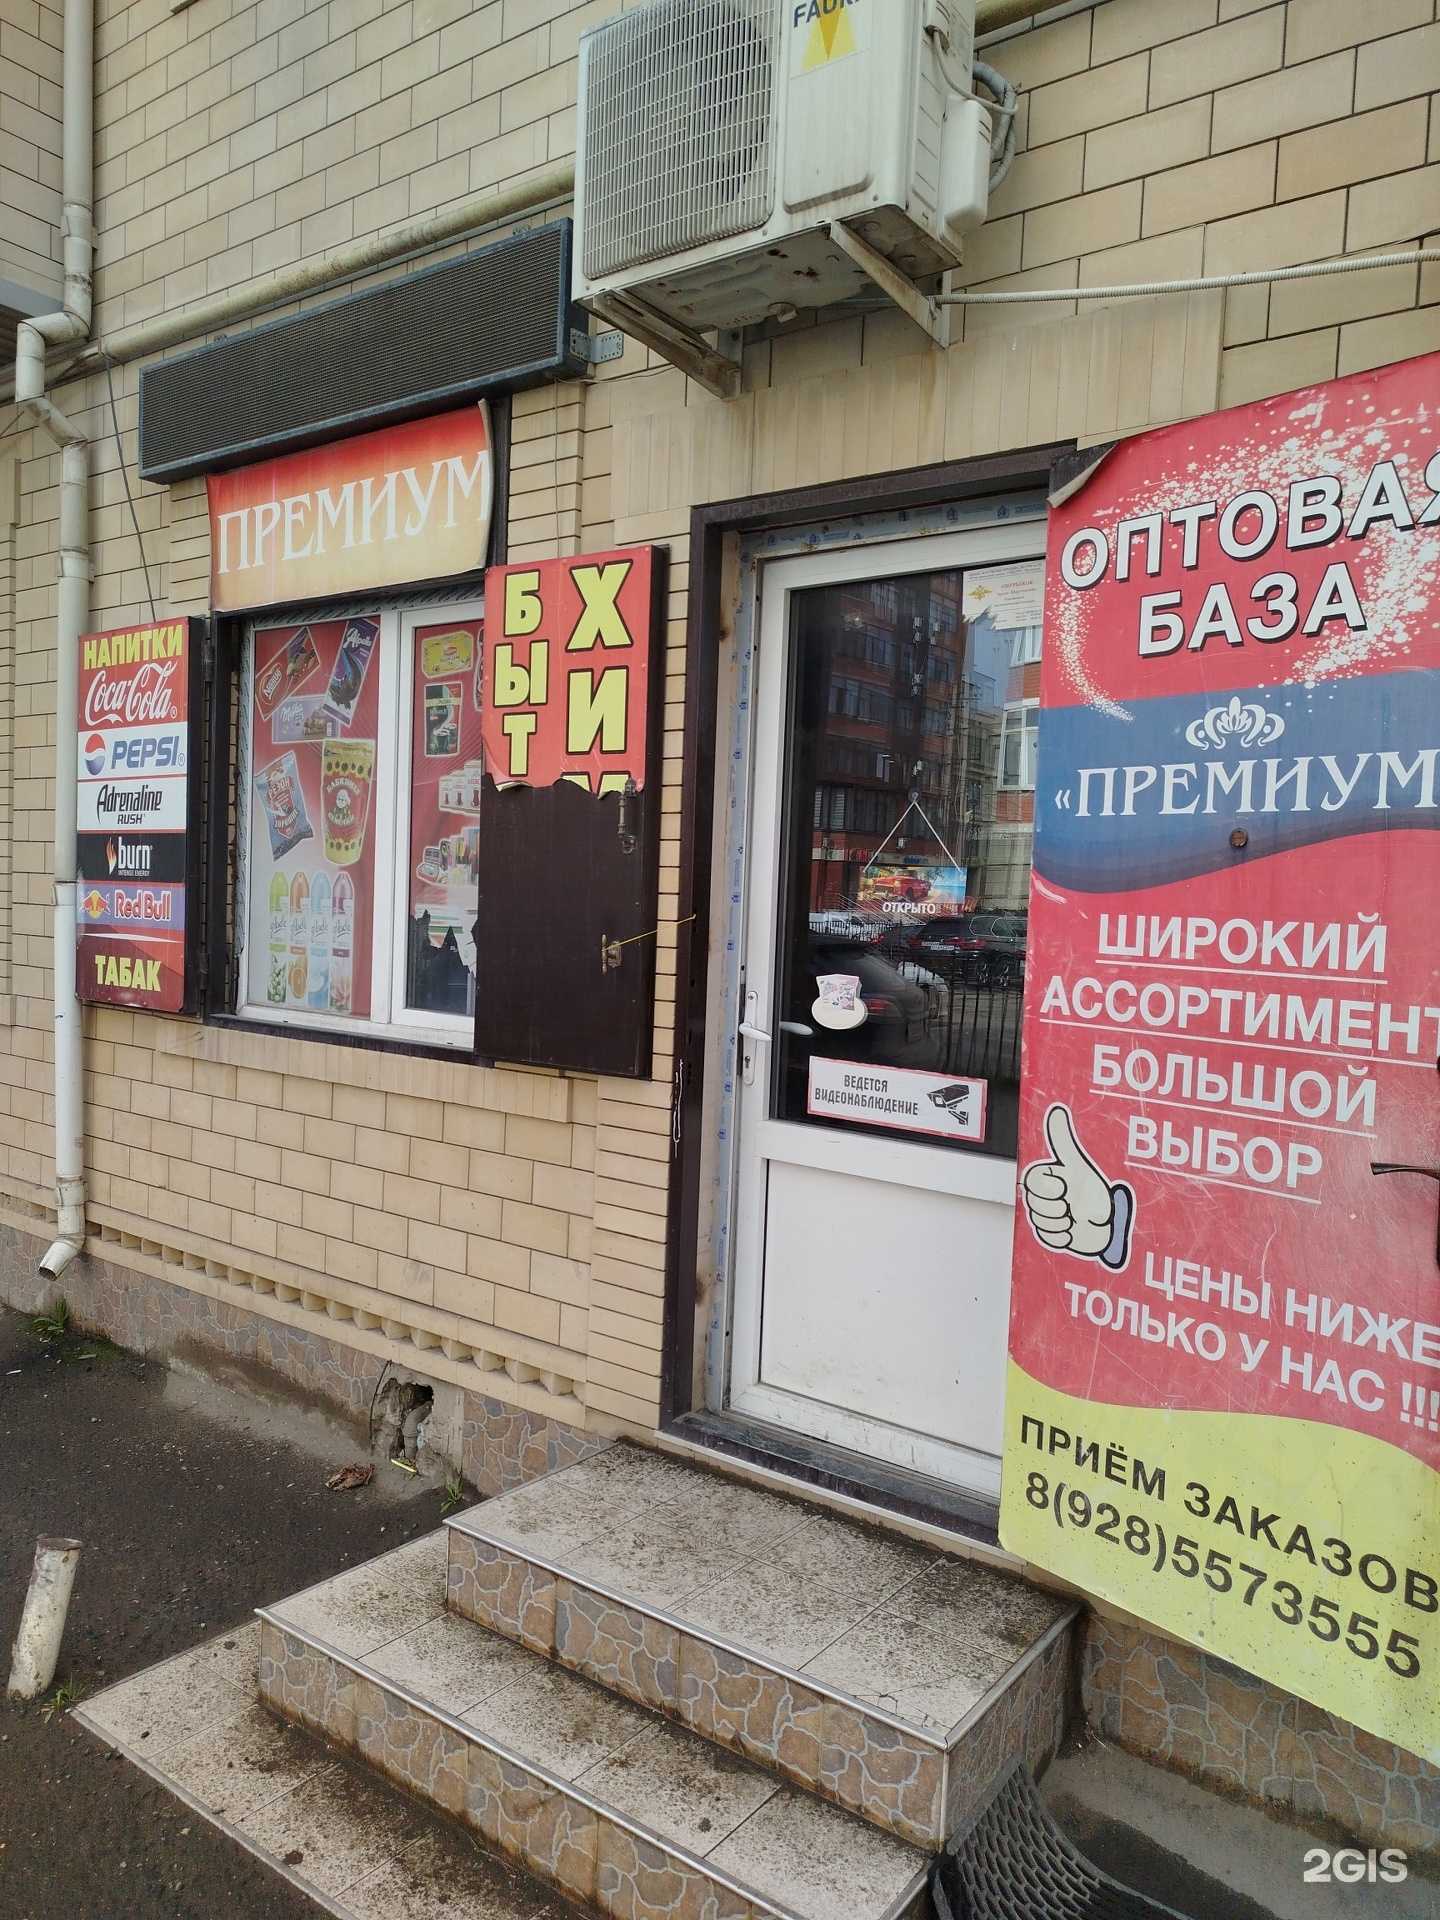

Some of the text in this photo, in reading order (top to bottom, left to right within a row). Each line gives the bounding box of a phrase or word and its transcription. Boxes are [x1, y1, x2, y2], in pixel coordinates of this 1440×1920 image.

[793, 0, 861, 28] FAU
[217, 450, 490, 574] ПРЕМИУМ
[1137, 561, 1367, 657] БАЗА
[84, 624, 183, 670] НАПИТКИ
[84, 660, 177, 727] Coca-Cola
[110, 735, 180, 769] PEPSI
[96, 784, 163, 824] Adrenaline
[117, 813, 143, 825] RUSH
[118, 836, 151, 869] burn
[114, 889, 172, 921] Red Bull
[882, 901, 936, 915] ОТКРЫТО
[1098, 911, 1388, 973] ШИРОКИЙ
[95, 954, 161, 992] ТАБАК
[814, 1087, 919, 1116] ВИДЕОНАБЛЮДЕНИЕ
[843, 1074, 889, 1093] ВЕДЕТСЯ
[1092, 1044, 1378, 1126] БОЛЬШОЙ
[1127, 1115, 1323, 1190] ВЫБОР
[1145, 1251, 1440, 1369] ЦЕНЫ НИЖЕ
[1064, 1281, 1227, 1362] ТОЛЬКО
[1239, 1333, 1269, 1373] У
[1281, 1351, 1386, 1413] НАС
[1020, 1414, 1440, 1615] ПРИЁМ ЗАКАЗОВ
[1025, 1471, 1421, 1679] 8(928)5573555
